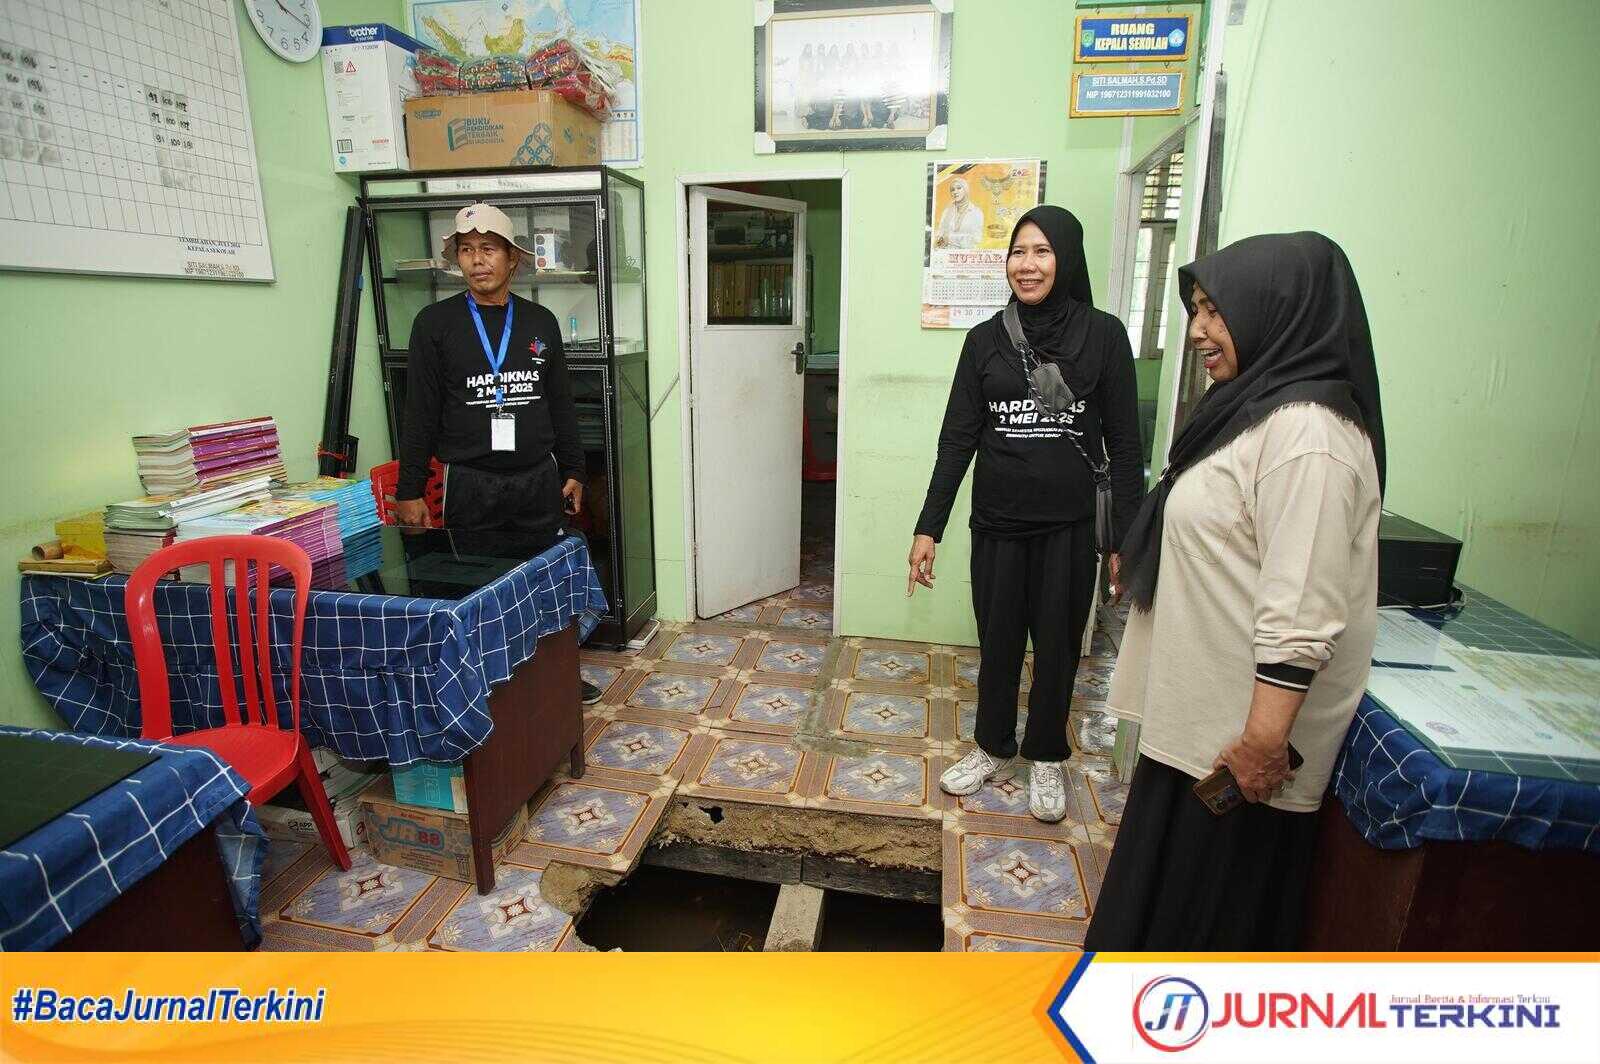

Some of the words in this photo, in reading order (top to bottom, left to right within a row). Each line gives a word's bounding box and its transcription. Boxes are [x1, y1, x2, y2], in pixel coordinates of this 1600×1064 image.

[348, 26, 378, 37] brother
[1110, 23, 1155, 35] RUANG
[1094, 37, 1127, 51] KEPALA
[1128, 36, 1169, 50] SEKOLAH
[1092, 76, 1105, 86] SITI
[1086, 91, 1098, 99] NIP
[466, 118, 491, 126] BUKU
[466, 124, 504, 132] PENDIDIKAN
[476, 388, 484, 398] 2
[509, 382, 534, 394] 2025
[999, 415, 1007, 425] 2
[1009, 412, 1039, 425] MEI
